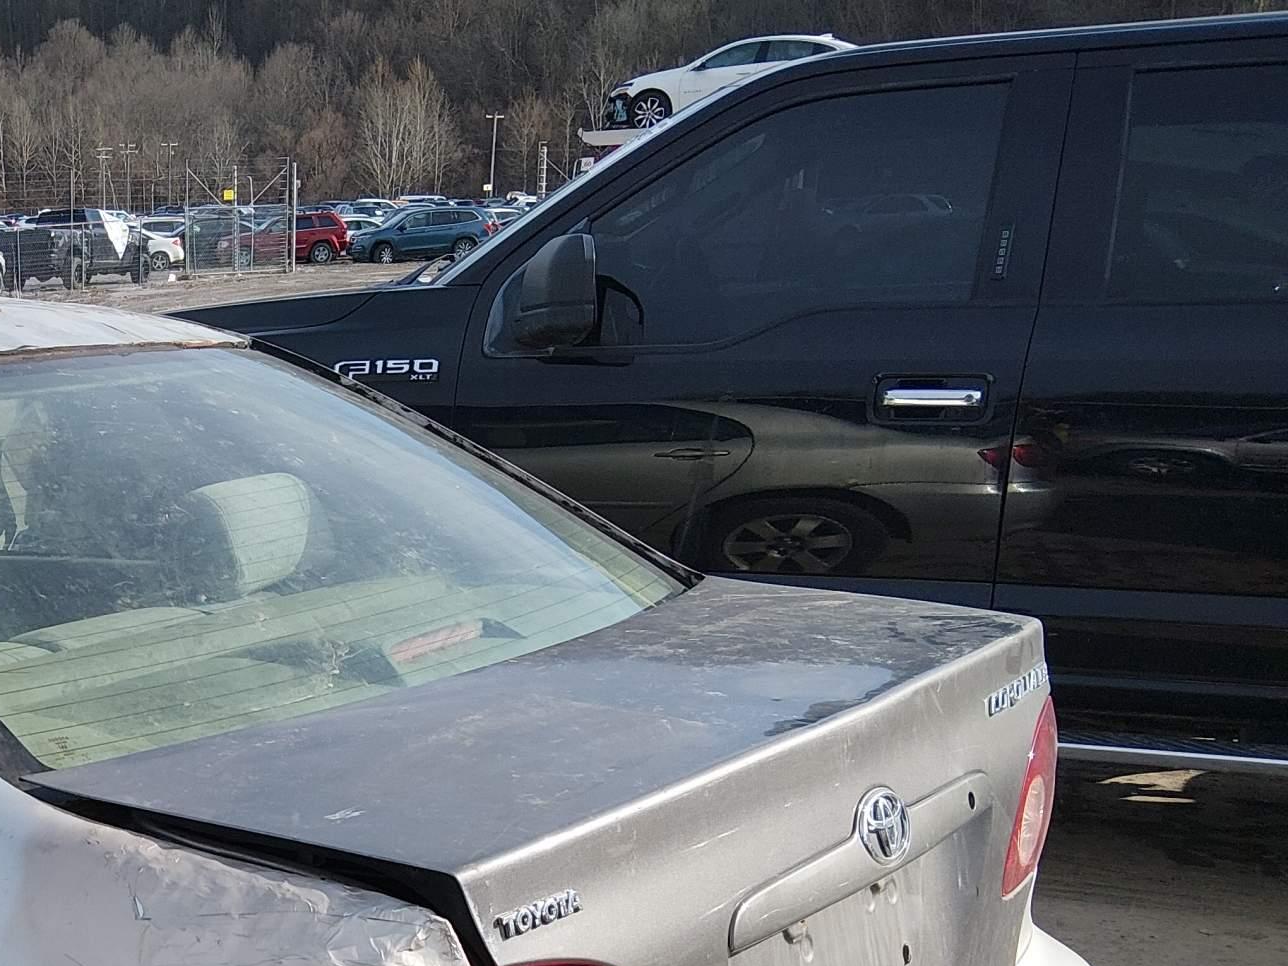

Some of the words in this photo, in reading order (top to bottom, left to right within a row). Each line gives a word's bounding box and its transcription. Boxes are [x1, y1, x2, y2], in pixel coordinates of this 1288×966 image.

[334, 359, 439, 379] F150
[409, 373, 432, 381] XLT
[492, 888, 584, 941] TOYOTA
